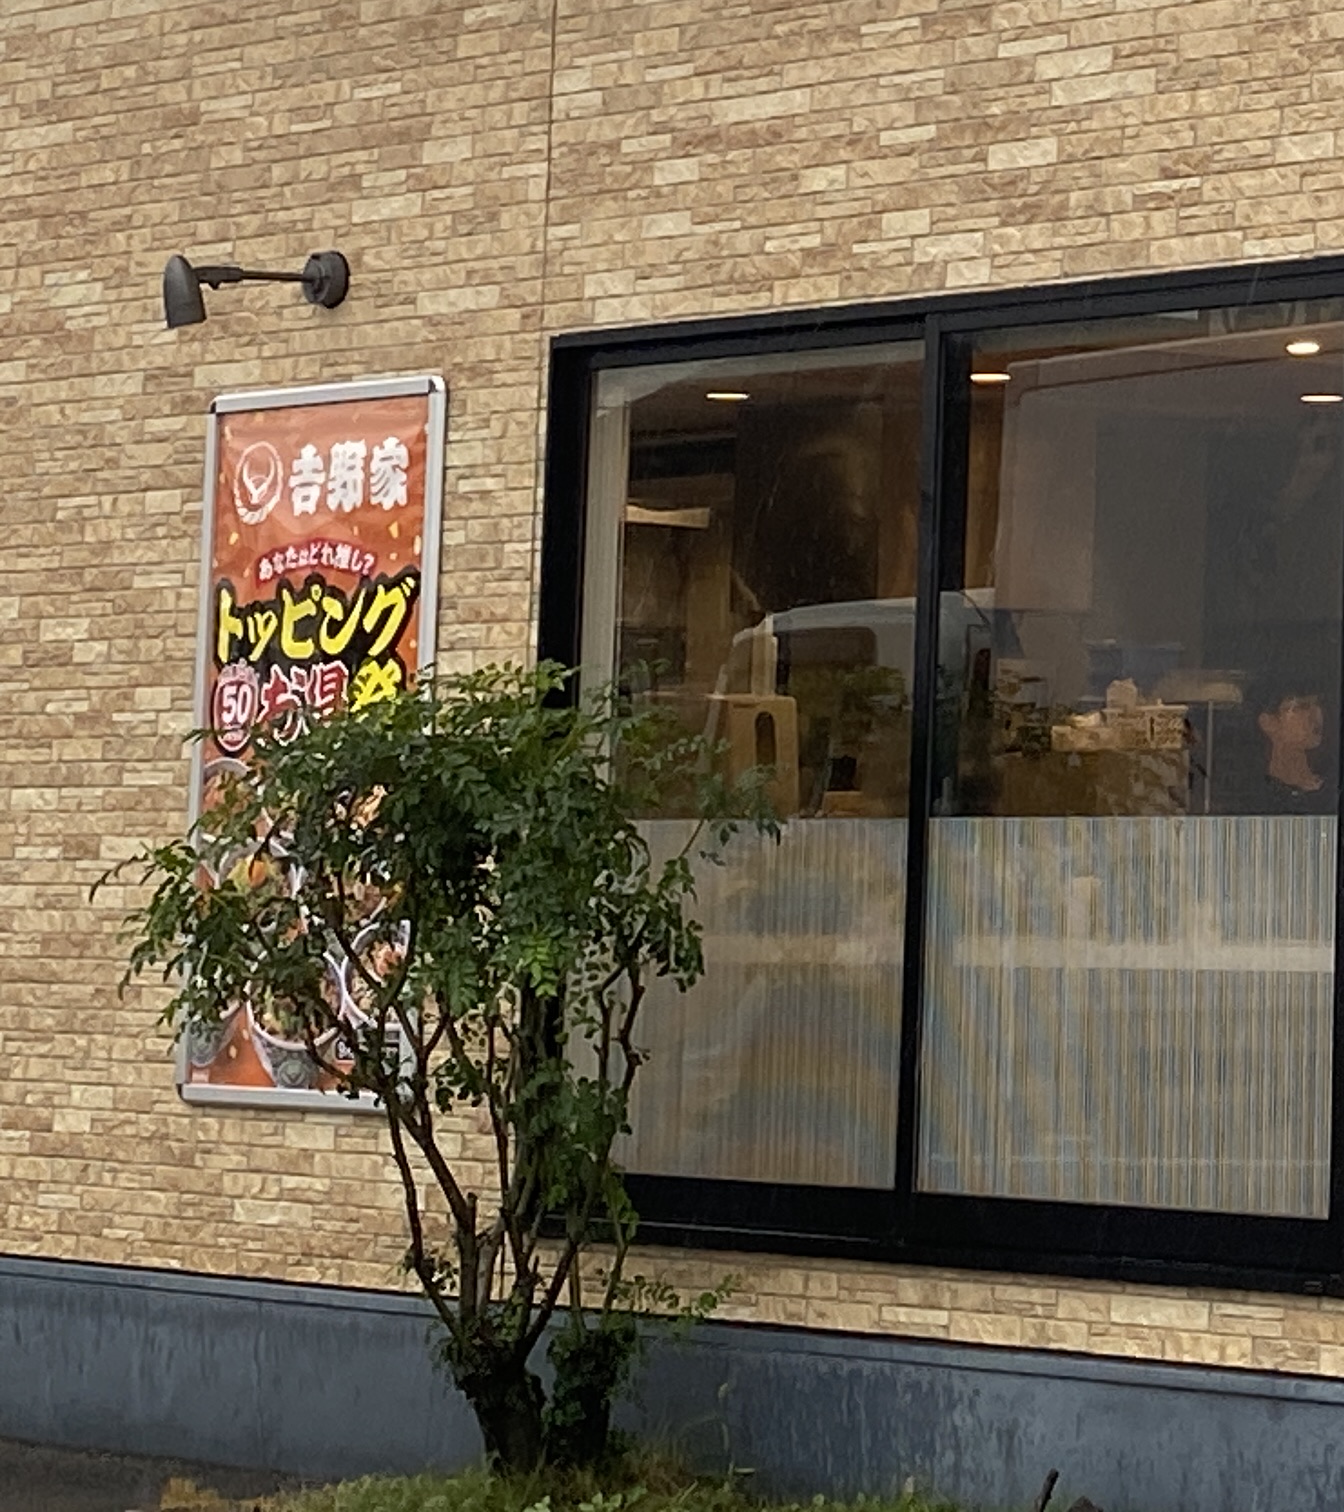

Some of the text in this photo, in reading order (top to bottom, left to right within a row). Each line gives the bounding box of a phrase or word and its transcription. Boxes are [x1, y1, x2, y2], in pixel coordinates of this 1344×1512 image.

[217, 576, 416, 663] トッピング
